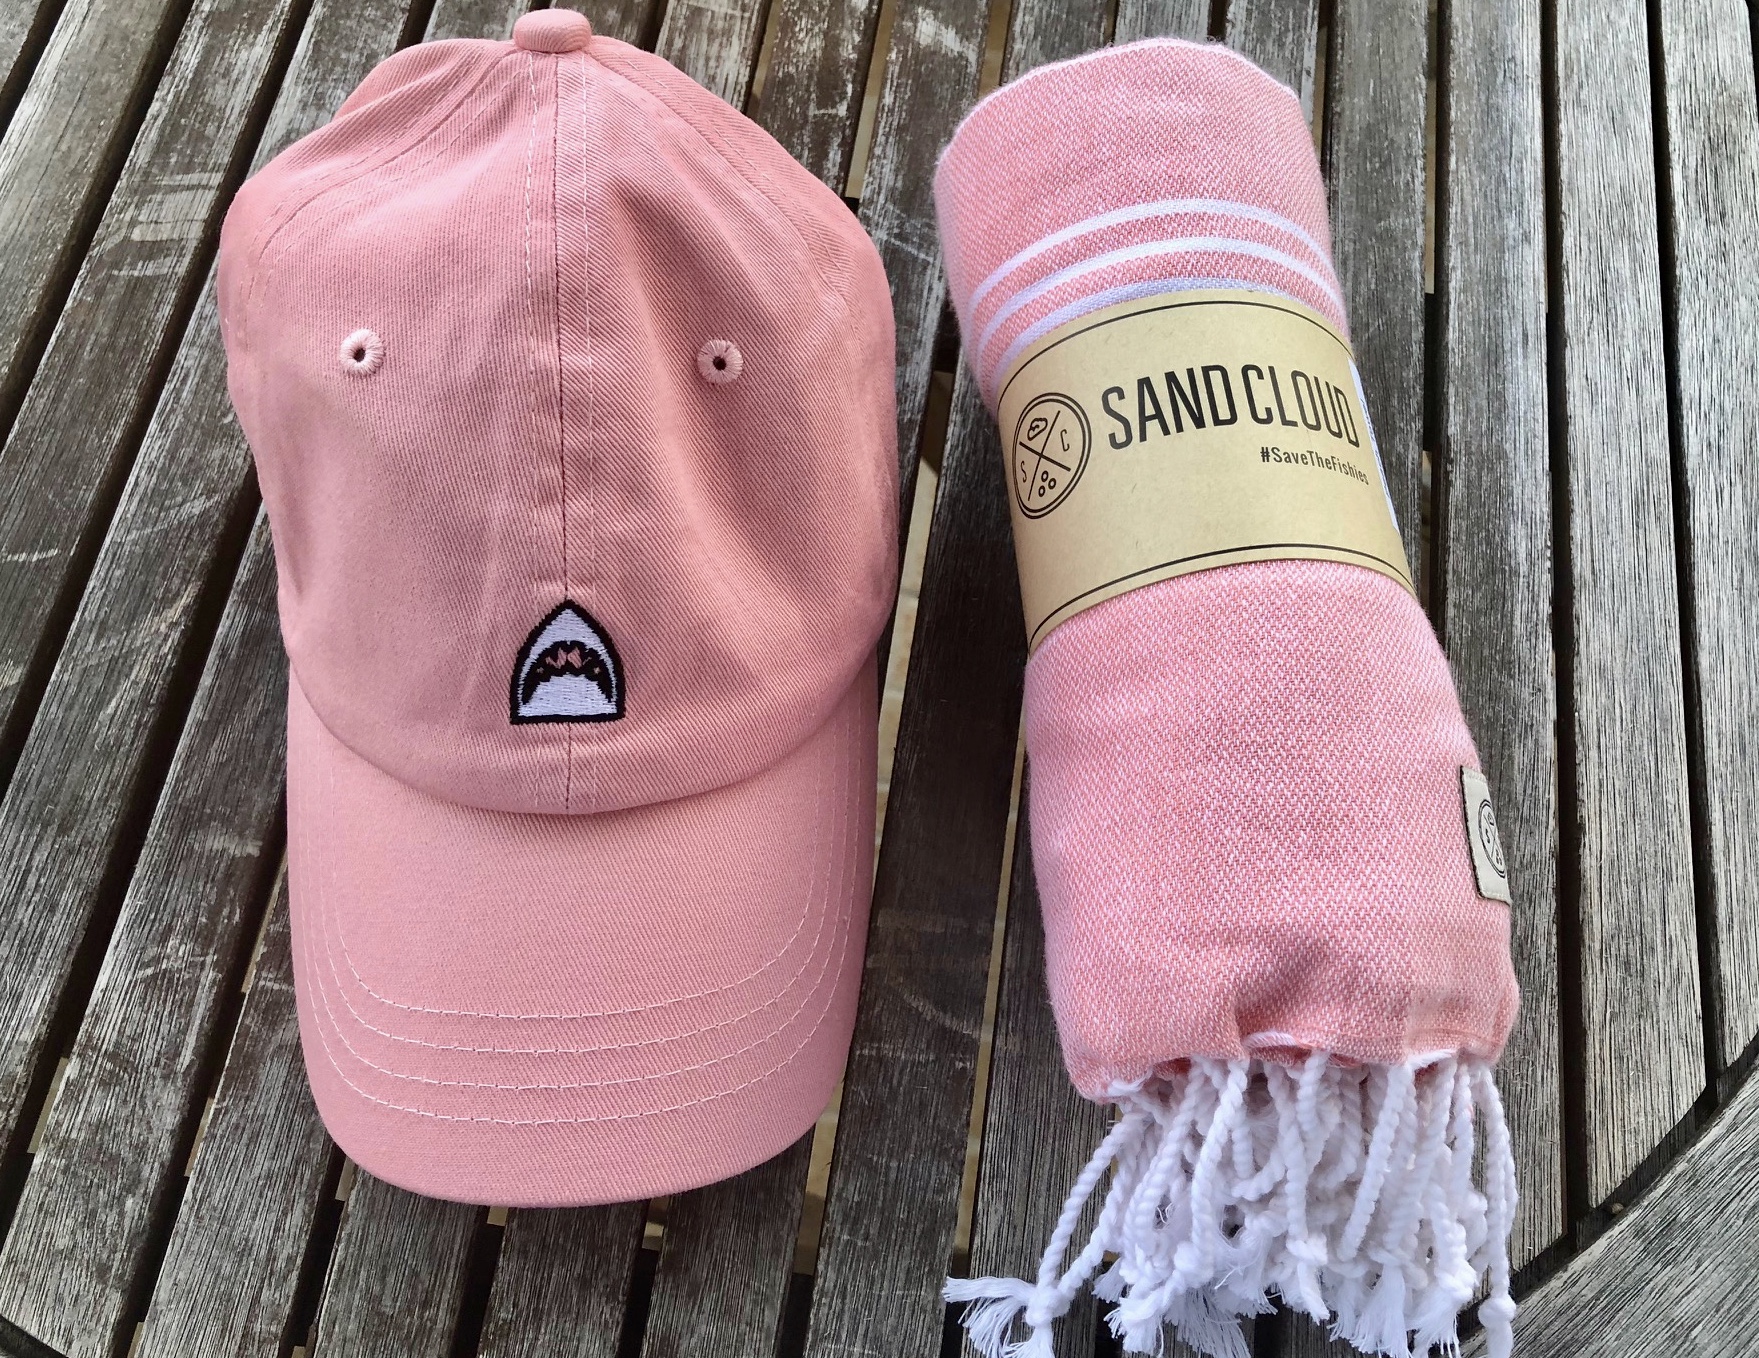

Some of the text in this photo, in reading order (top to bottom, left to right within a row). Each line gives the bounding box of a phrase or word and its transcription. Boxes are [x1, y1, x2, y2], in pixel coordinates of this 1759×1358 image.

[1102, 364, 1237, 450] SAND
[1241, 365, 1360, 448] CLOUD
[1059, 428, 1071, 452] C
[1020, 460, 1028, 483] S
[1260, 446, 1370, 485] #SaveTheFishies
